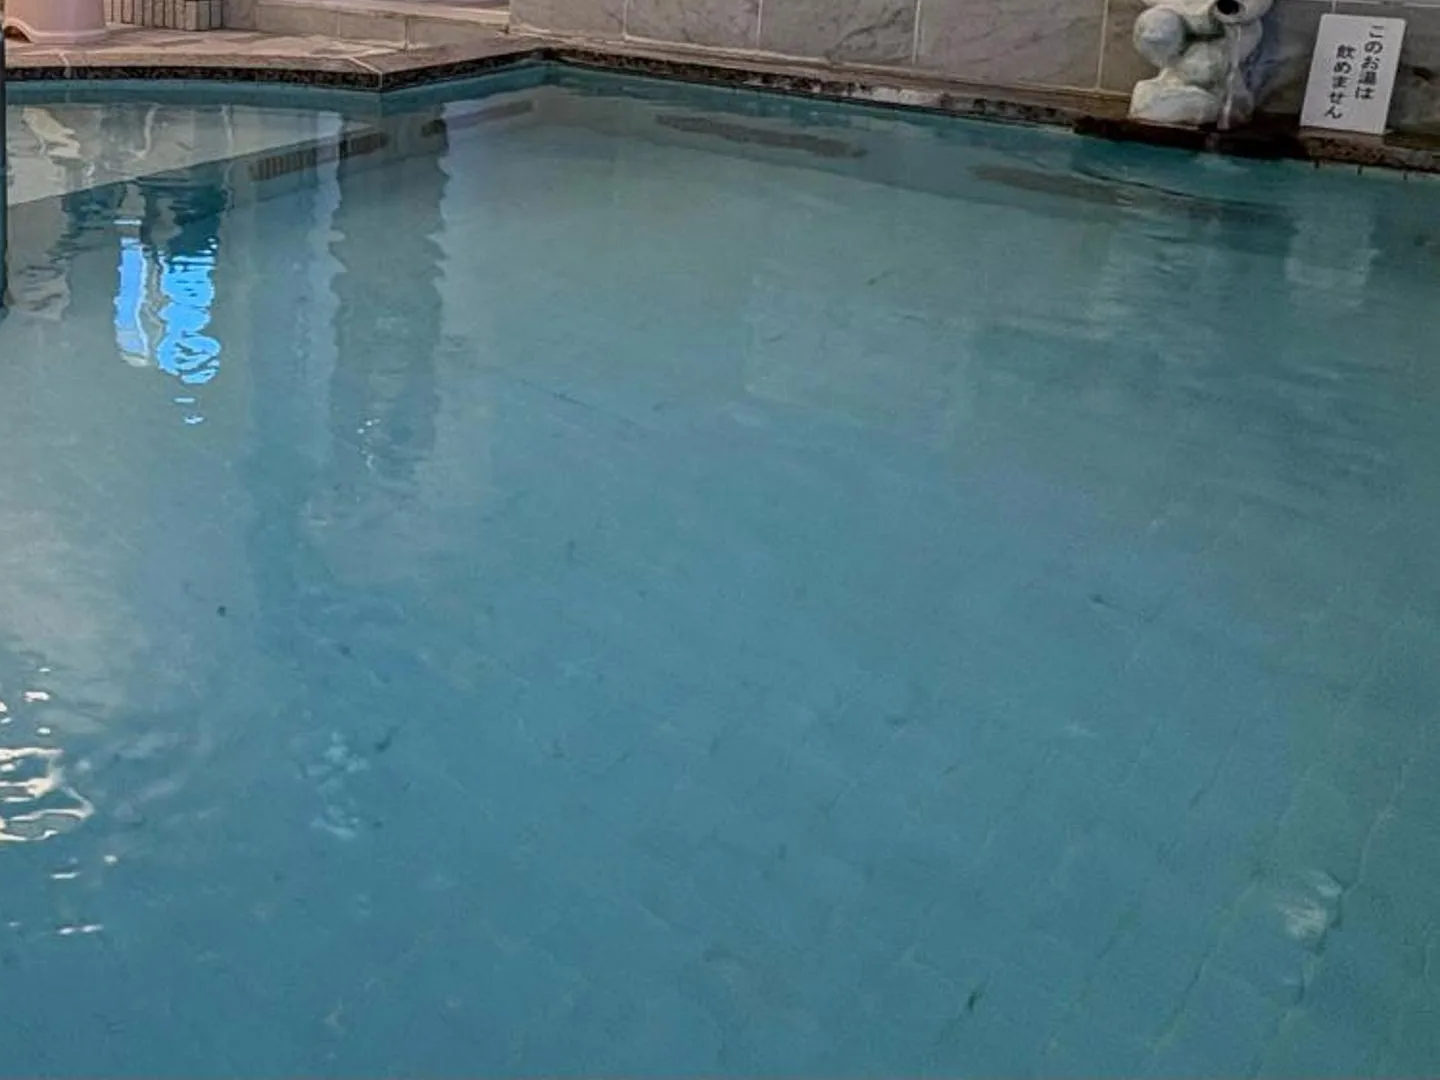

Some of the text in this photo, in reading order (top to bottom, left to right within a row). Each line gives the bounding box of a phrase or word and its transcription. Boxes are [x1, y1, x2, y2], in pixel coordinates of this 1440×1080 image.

[1324, 44, 1356, 119] 飲めません
[1355, 25, 1384, 100] このお湯は
